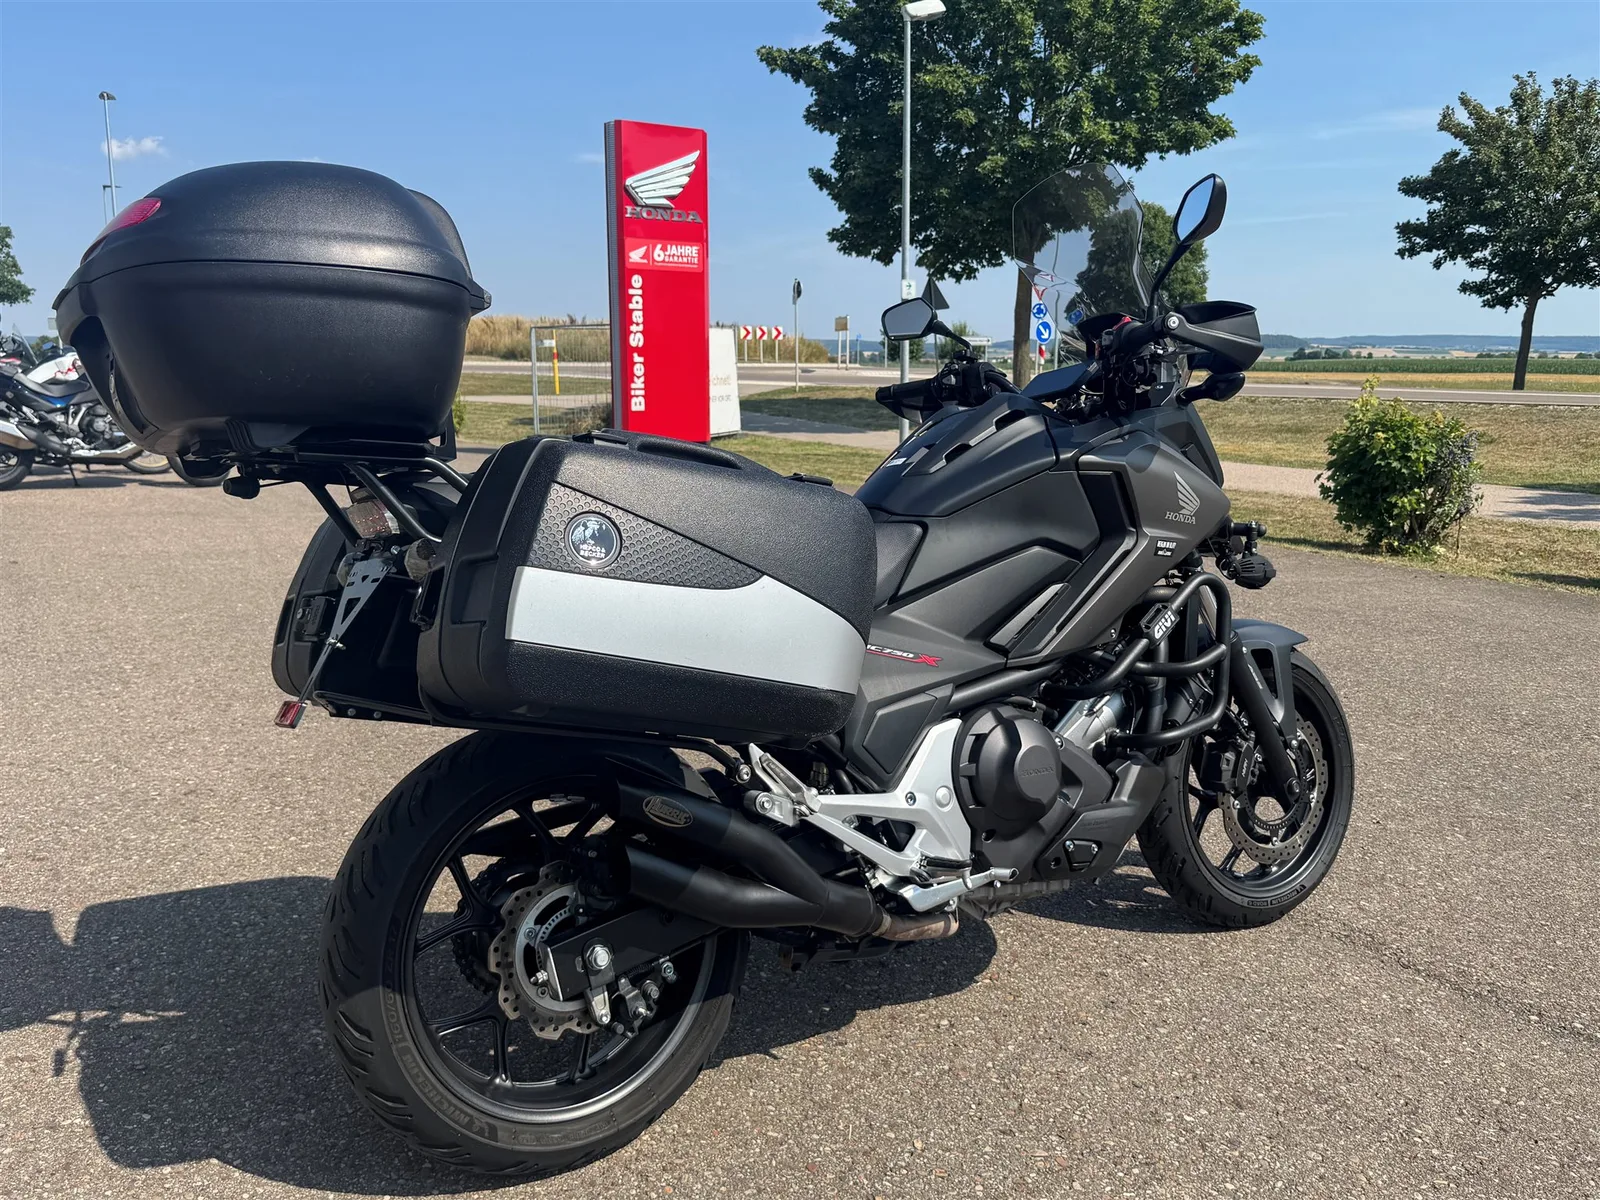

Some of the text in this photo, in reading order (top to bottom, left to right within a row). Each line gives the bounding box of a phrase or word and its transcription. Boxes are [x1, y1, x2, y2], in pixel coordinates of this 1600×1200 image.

[624, 205, 703, 223] HONDA
[653, 243, 700, 262] 6 JAHRE
[664, 256, 699, 264] GARANTIE
[628, 274, 645, 411] Biker Stable
[1164, 511, 1196, 525] HONDA
[580, 550, 605, 558] BECKER
[918, 653, 943, 668] X
[401, 1053, 471, 1127] MICHELIN
